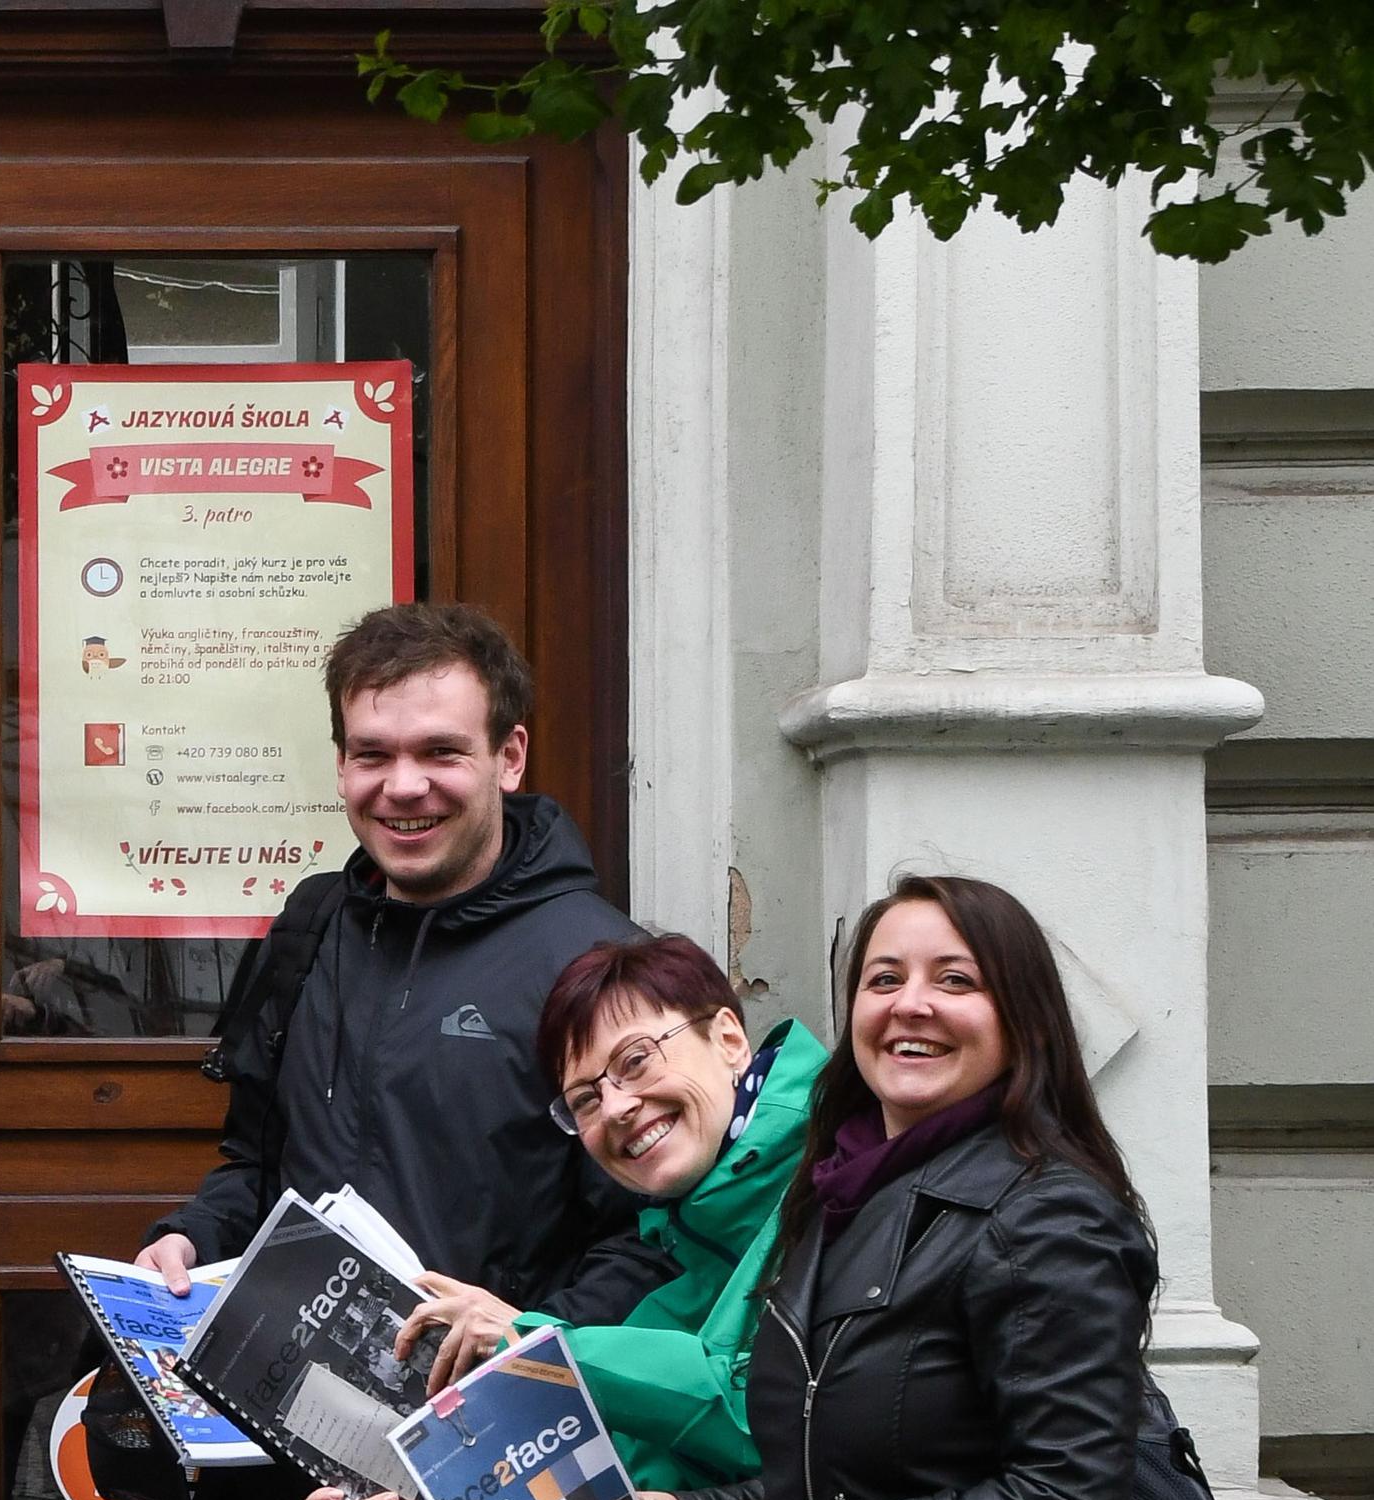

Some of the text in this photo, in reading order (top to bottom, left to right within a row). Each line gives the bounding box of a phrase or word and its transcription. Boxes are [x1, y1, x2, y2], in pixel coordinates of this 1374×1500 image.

[121, 403, 310, 428] JAZYKOVÁ ŠKOLA
[139, 457, 293, 477] VISTA ALEGRE
[181, 504, 253, 530] 3. patro
[140, 555, 348, 571] Chcete poradit, jaký kurz je pro vás
[140, 570, 352, 586] nejlepší? Napište nám nebo zavolejte
[140, 585, 308, 598] a domluvte si osobní schůzku.
[140, 627, 323, 642] Výuka angličtiny, francouzštiny,
[140, 643, 191, 656] němčiny,
[194, 643, 260, 657] španělštiny,
[263, 642, 309, 656] italštiny
[313, 645, 320, 653] a
[140, 658, 184, 672] probíhá
[187, 658, 202, 669] od
[205, 658, 246, 672] pondělí
[249, 658, 264, 668] do
[267, 657, 299, 672] pátku
[302, 657, 316, 668] od
[140, 674, 191, 685] do 21:00
[141, 724, 186, 736] Kontakt
[176, 746, 283, 758] +420 739 080 851
[176, 771, 286, 786] www.vistaalegre.cz
[176, 802, 347, 816] www.facebook.com/jsvistaale
[138, 839, 302, 865] VÍTEJTE U NÁS
[243, 1256, 361, 1411] face2face
